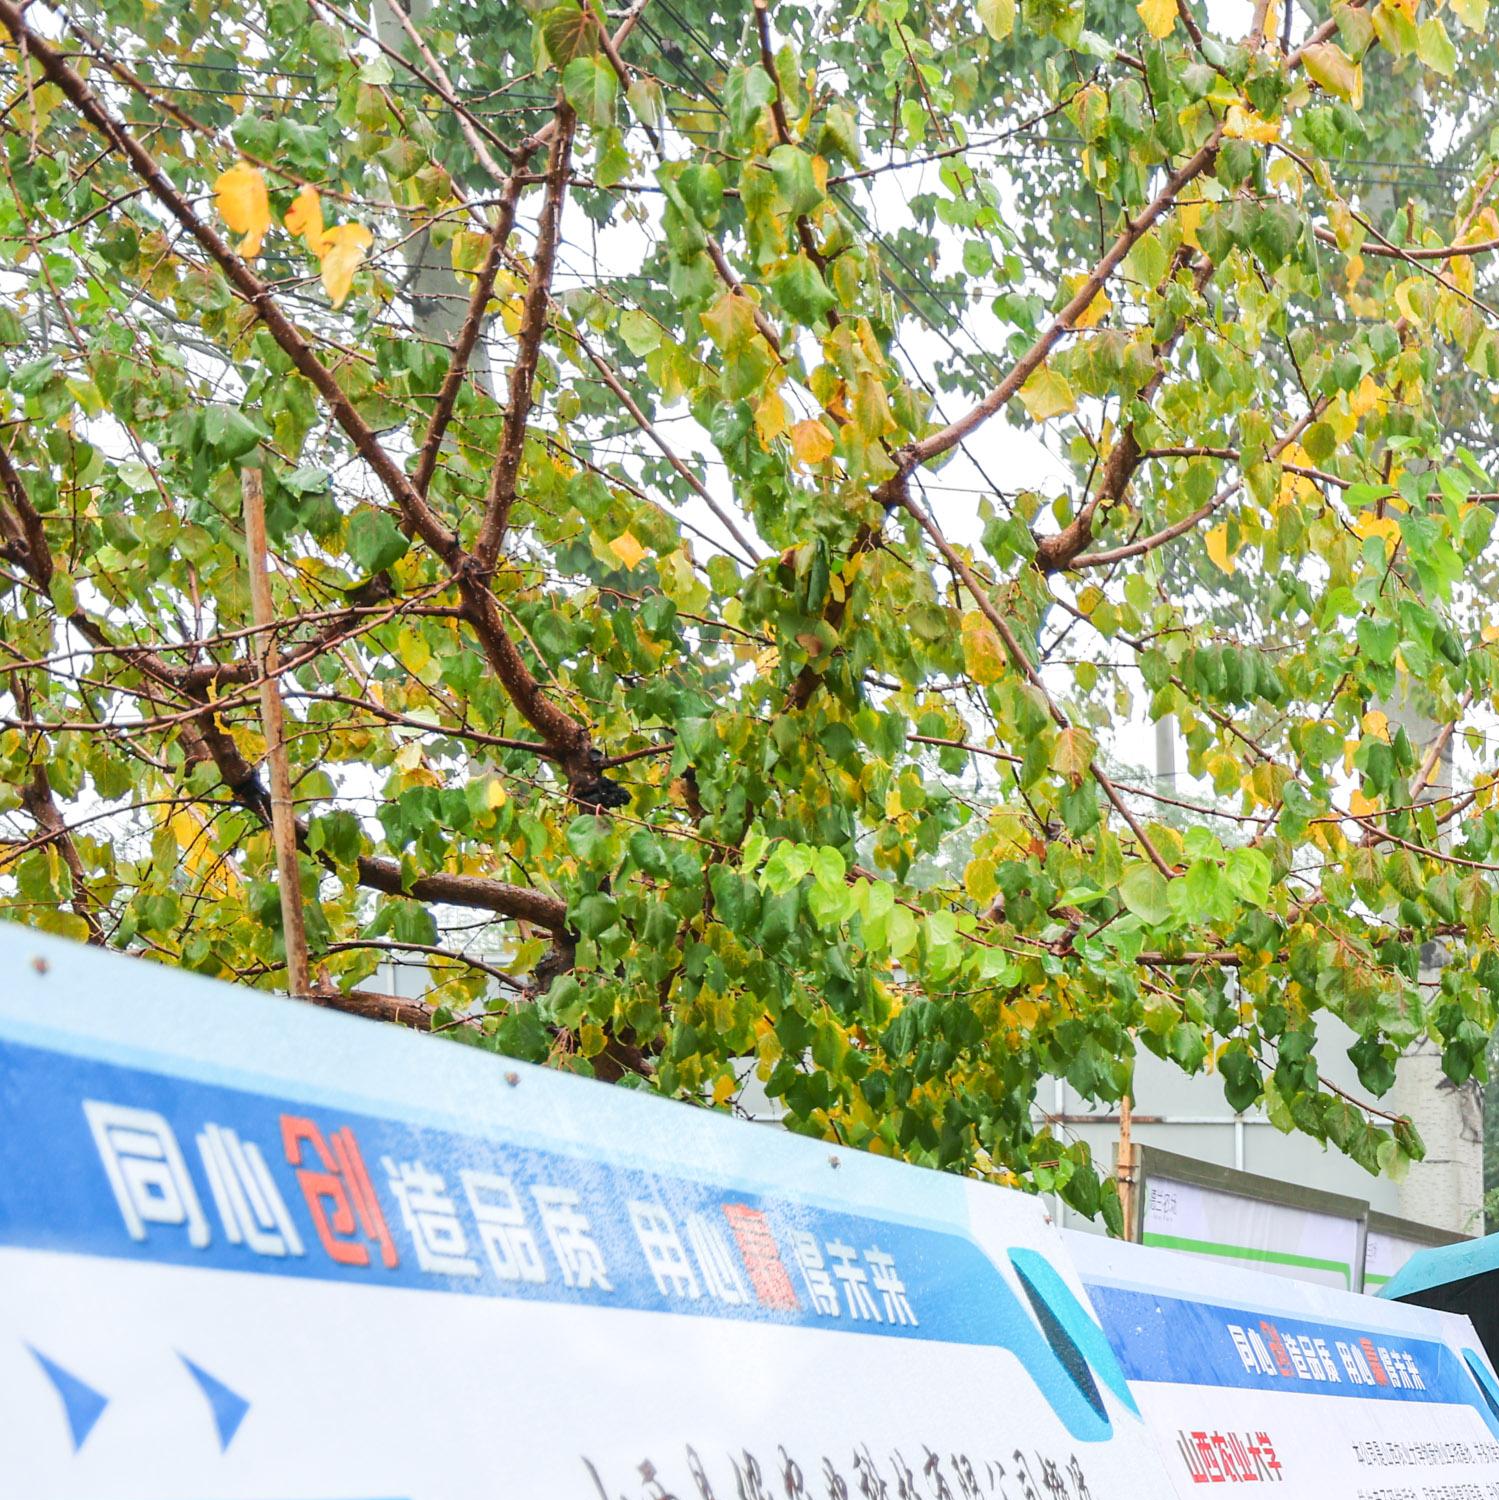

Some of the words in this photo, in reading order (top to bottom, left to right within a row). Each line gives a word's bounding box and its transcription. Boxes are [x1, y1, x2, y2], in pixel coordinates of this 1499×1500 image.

[82, 1098, 615, 1292] 同心创造品质
[627, 1202, 919, 1328] 用心赢得未来
[1226, 1320, 1342, 1384] 同心创造品质
[1335, 1335, 1427, 1391] 用心赢得未来
[1177, 1429, 1283, 1484] 山西农业大学
